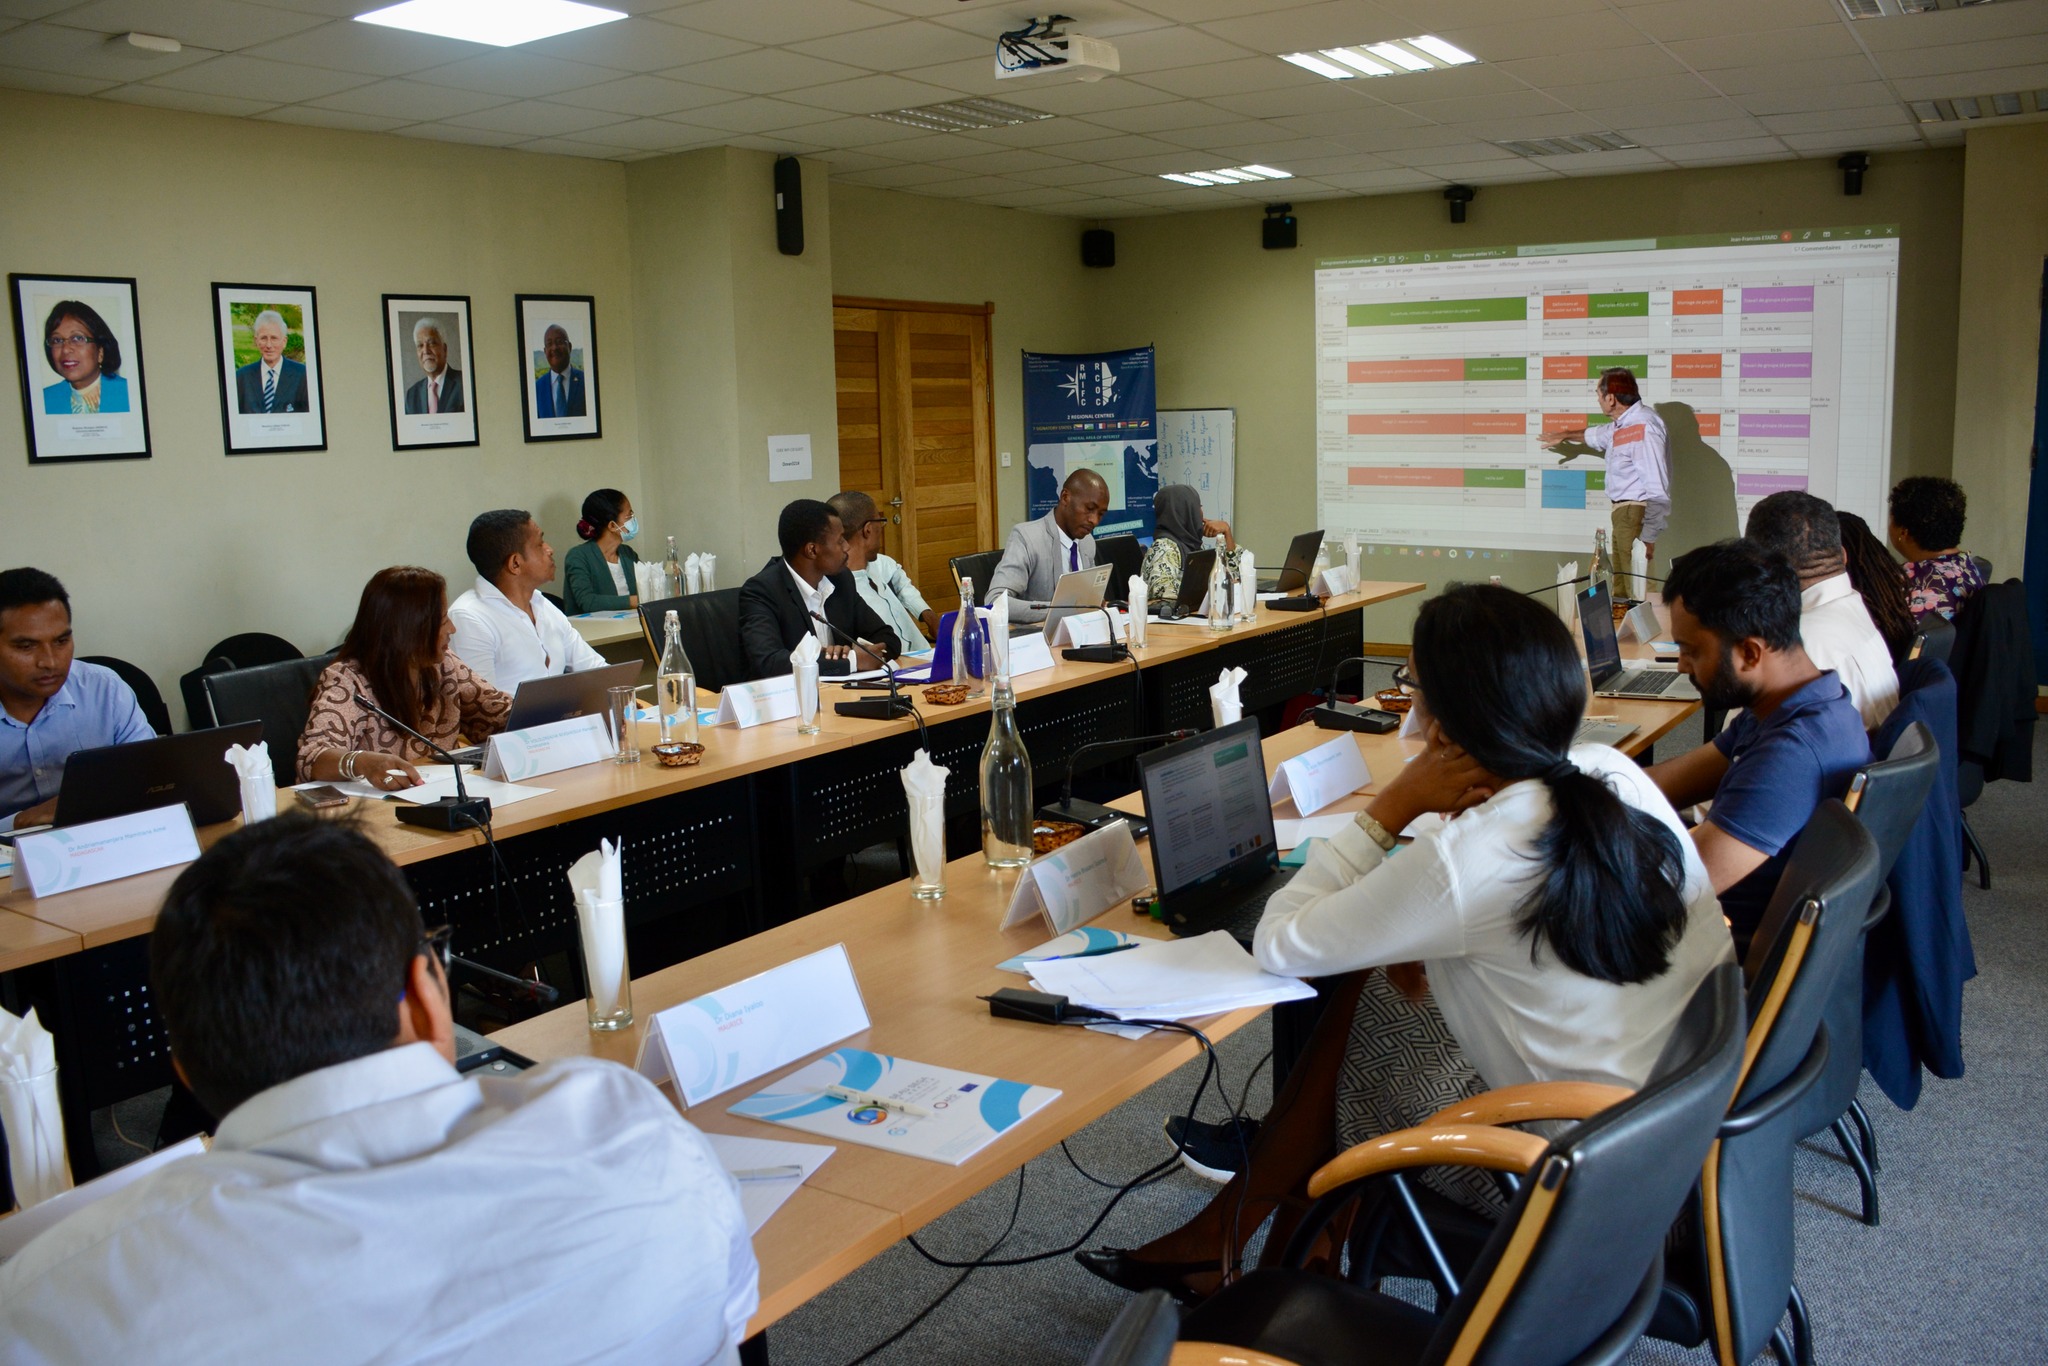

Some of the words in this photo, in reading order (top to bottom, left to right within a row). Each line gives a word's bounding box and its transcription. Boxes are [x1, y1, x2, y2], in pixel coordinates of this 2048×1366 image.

[1860, 242, 1884, 250] Partager
[1097, 521, 1142, 532] COORDINATION
[145, 782, 176, 794] ASUS
[724, 1009, 743, 1020] Diana
[744, 1000, 764, 1012] Iyaloo
[718, 1017, 743, 1032] MAURICE
